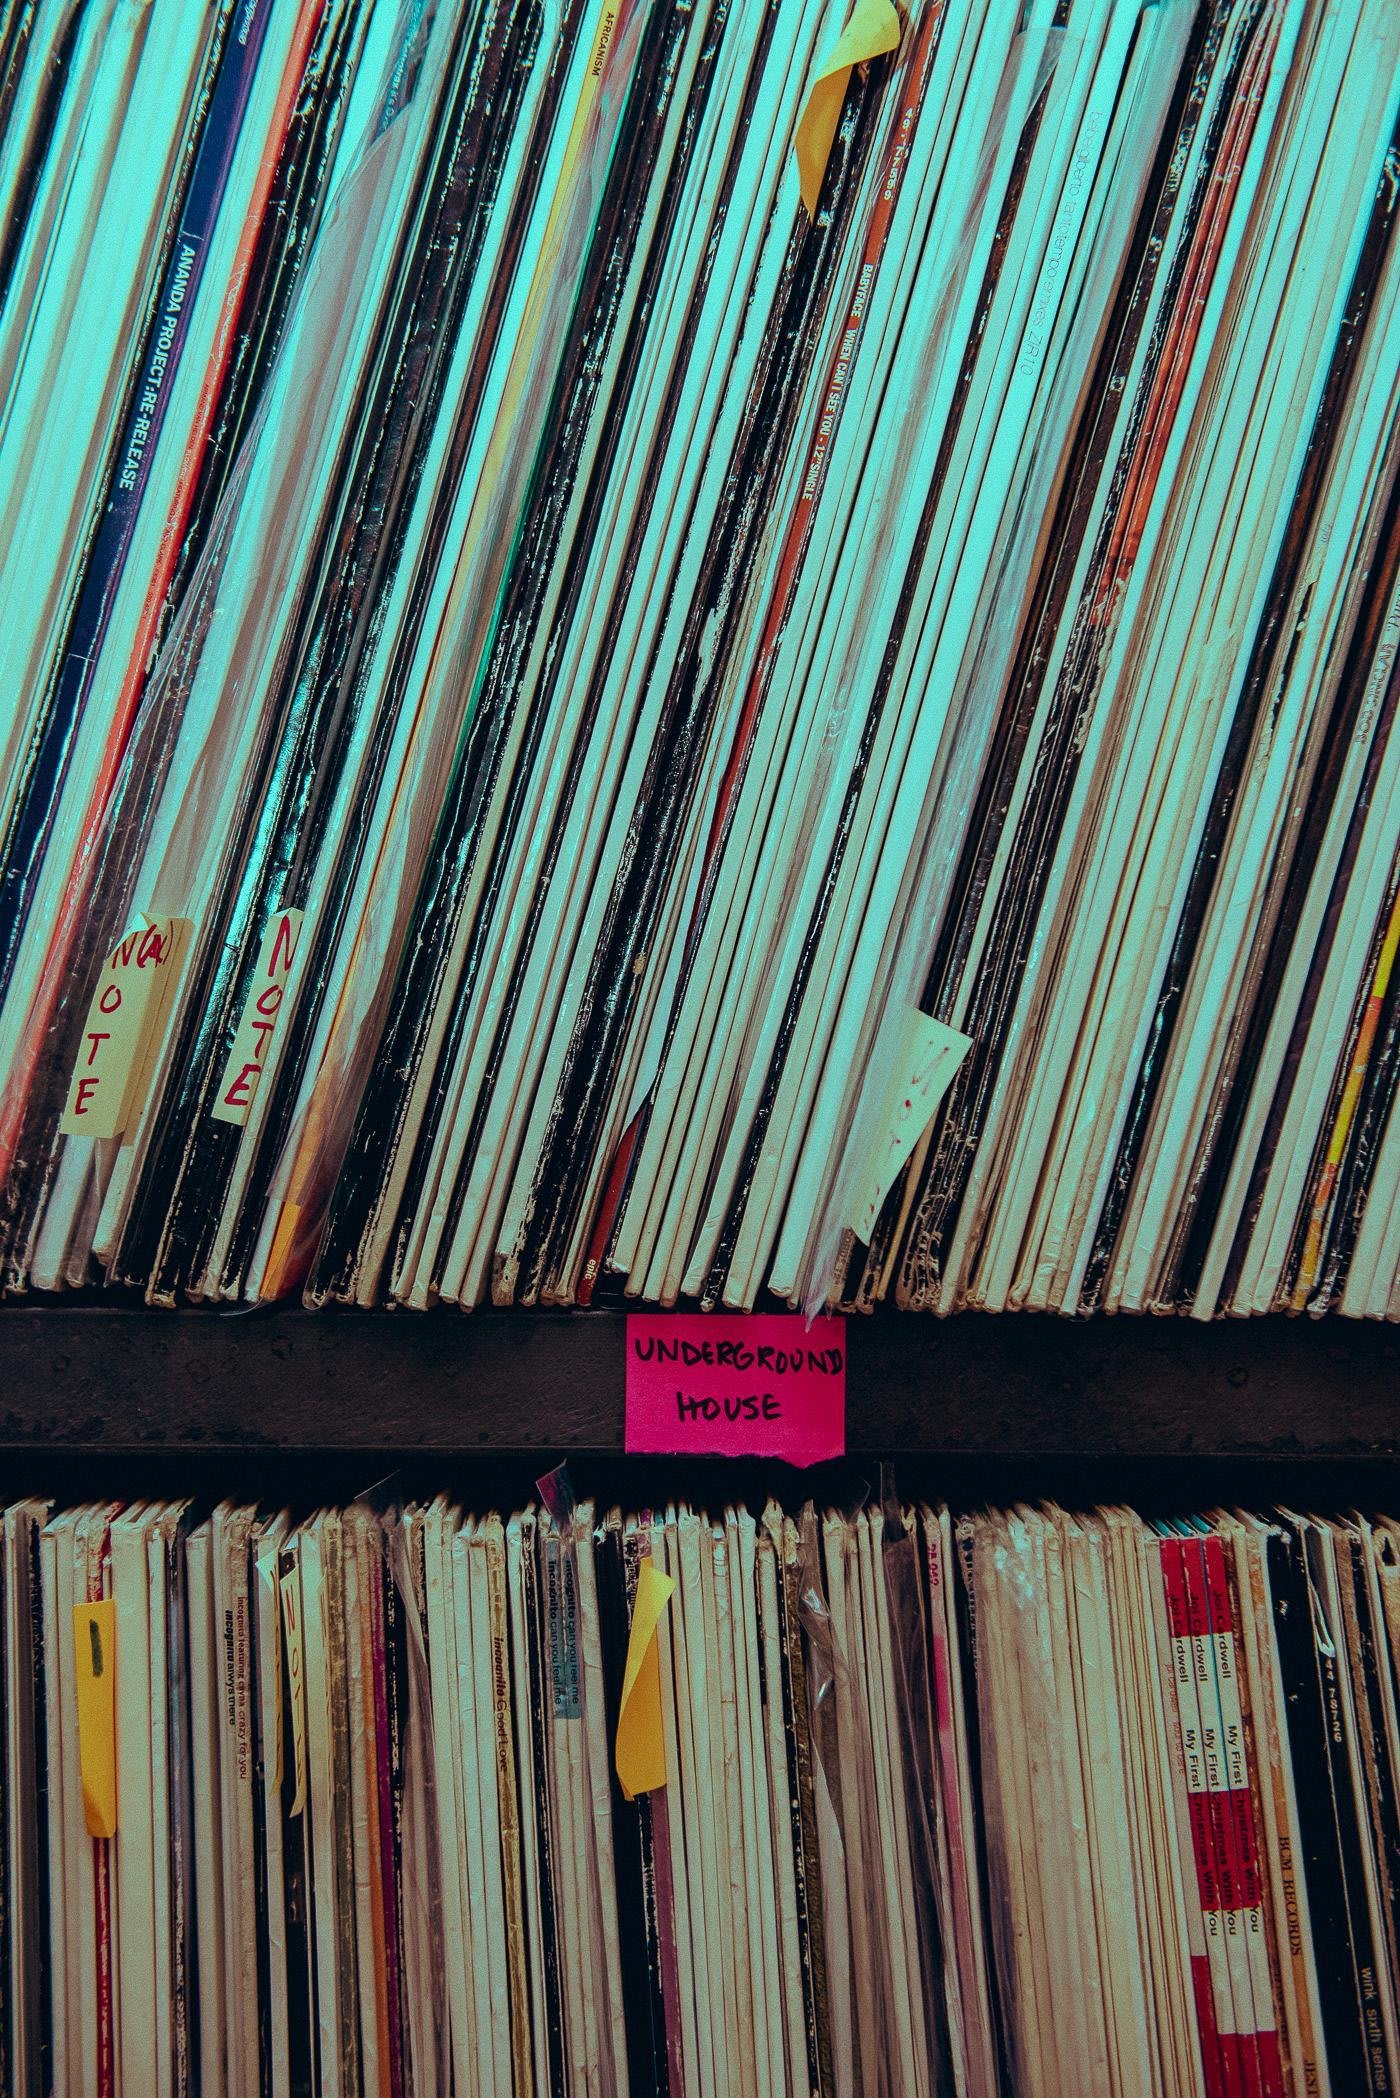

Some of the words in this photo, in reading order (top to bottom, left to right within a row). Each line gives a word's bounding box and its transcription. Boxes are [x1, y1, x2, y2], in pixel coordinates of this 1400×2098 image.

[591, 10, 615, 77] AFRICANISM
[165, 244, 196, 314] ANANDA
[849, 262, 874, 318] BABYFACE
[838, 327, 857, 361] WHEN
[832, 361, 848, 384] CAN
[830, 384, 841, 392] I
[824, 391, 840, 413] SEE
[818, 412, 834, 436] YOU
[224, 915, 303, 1106] NOTE
[582, 1258, 598, 1280] epic
[635, 1337, 844, 1375] UNDERGROUND
[676, 1391, 783, 1422] HOUSE
[550, 1621, 558, 1640] can
[566, 1620, 576, 1640] can
[550, 1643, 559, 1662] you
[567, 1643, 576, 1663] you
[552, 1664, 561, 1684] feel
[554, 1687, 562, 1704] me
[571, 1687, 579, 1703] me
[237, 1710, 245, 1738] crazy
[496, 1700, 508, 1736] Good
[238, 1743, 246, 1755] for
[1183, 1728, 1196, 1750] My
[1203, 1728, 1216, 1749] My
[1226, 1725, 1239, 1746] My
[238, 1760, 246, 1779] you
[498, 1741, 509, 1771] Love
[1208, 1752, 1221, 1787] First
[1230, 1749, 1244, 1784] First
[1188, 1754, 1201, 1788] First
[1278, 1835, 1292, 1870] BCM
[1207, 1908, 1219, 1936] You
[1226, 1908, 1239, 1935] You
[1249, 1906, 1261, 1932] You
[1282, 1879, 1302, 1956] RECORDS
[1360, 1966, 1377, 1999] wink
[1365, 2008, 1382, 2042] sixth
[1370, 2046, 1387, 2091] sense
